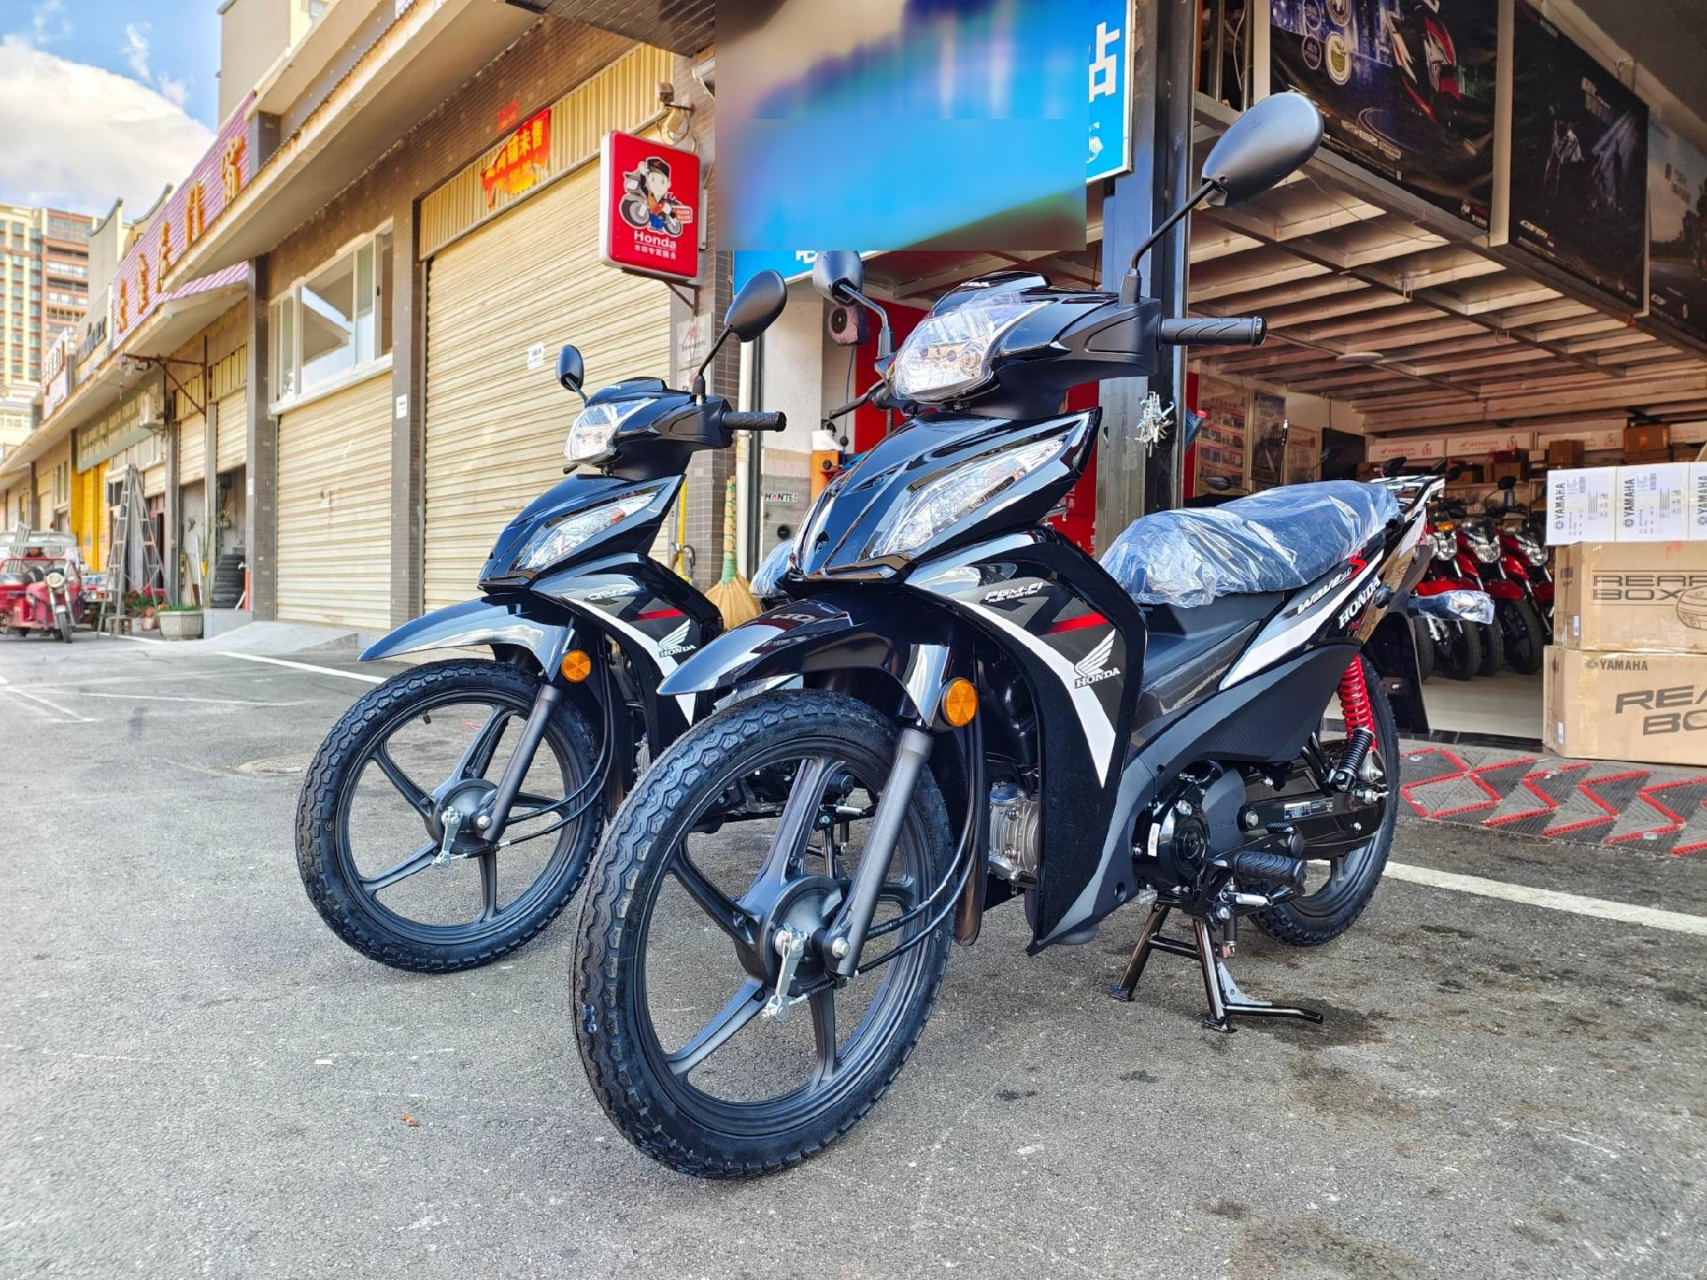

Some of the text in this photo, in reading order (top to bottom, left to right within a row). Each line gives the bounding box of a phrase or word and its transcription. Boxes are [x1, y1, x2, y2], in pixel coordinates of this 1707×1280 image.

[634, 230, 677, 250] Honda
[1555, 482, 1566, 521] YAMAHA
[1624, 478, 1635, 518] YAMAHA
[1697, 475, 1707, 516] YAMAHA
[985, 582, 1044, 601] PGM-FI
[1593, 589, 1686, 601] BOX
[1338, 576, 1382, 630] HONDA
[659, 644, 696, 658] HONDA
[1600, 660, 1648, 671] YAMAHA
[1075, 667, 1121, 689] HONDA
